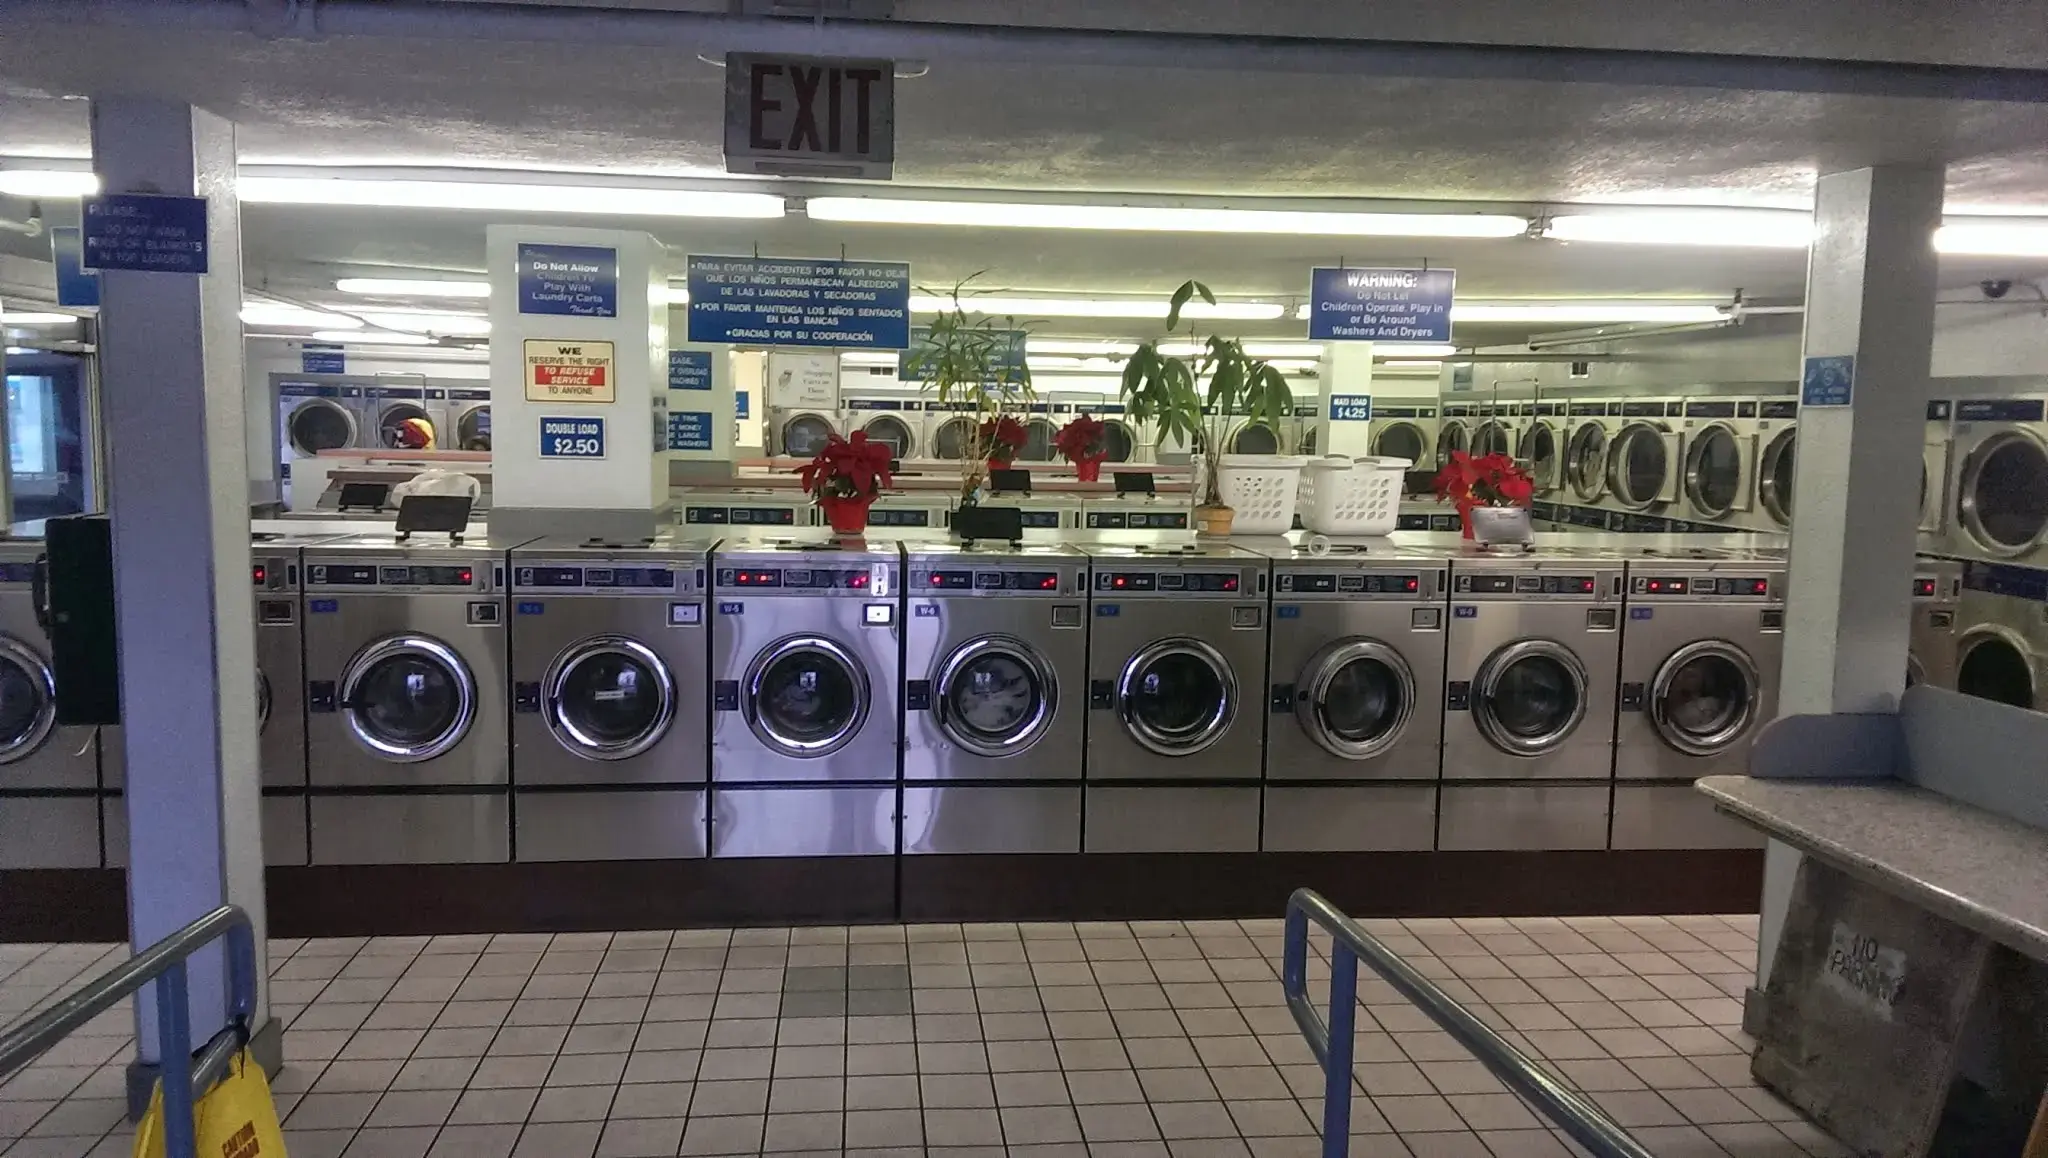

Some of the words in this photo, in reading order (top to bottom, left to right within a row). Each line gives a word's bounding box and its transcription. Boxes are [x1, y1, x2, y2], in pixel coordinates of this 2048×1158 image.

[750, 65, 881, 154] EXIT
[533, 262, 547, 270] Do
[550, 262, 568, 271] Not
[570, 263, 599, 273] Allow
[697, 262, 719, 271] PARA
[724, 263, 753, 272] EVITAR
[758, 264, 811, 275] ACCIDENTES
[816, 267, 834, 275] POR
[839, 267, 864, 276] FAVOR
[869, 269, 881, 277] NO
[537, 271, 581, 281] Children
[706, 274, 724, 283] QUE
[729, 275, 746, 283] LOS
[751, 274, 776, 284] NIÑOS
[781, 277, 844, 287] PERMANESCAN
[848, 280, 899, 288] ALREDEDOR
[1347, 272, 1418, 288] WARNING:
[544, 282, 566, 292] Play
[569, 283, 592, 292] With
[532, 292, 575, 303] Laundry
[576, 293, 603, 303] Carts
[721, 287, 733, 295] DE
[737, 288, 754, 296] LAS
[759, 289, 810, 298] LAVADORAS
[814, 291, 820, 299] Y
[824, 291, 876, 300] SECADORAS
[1357, 291, 1371, 300] Do
[1374, 291, 1392, 300] Not
[1394, 292, 1409, 300] Let
[701, 303, 719, 311] POR
[724, 303, 751, 312] FAVOR
[755, 304, 803, 314] MANTENGA
[807, 306, 825, 315] LOS
[829, 305, 854, 316] NIÑOS
[858, 308, 903, 318] SENTADOS
[1321, 302, 1363, 311] Children
[1410, 303, 1431, 315] Play
[766, 315, 779, 323] EN
[782, 315, 799, 324] LAS
[804, 316, 839, 326] BANCAS
[1350, 316, 1360, 324] or
[1364, 315, 1377, 324] Be
[1380, 315, 1417, 325] Around
[732, 329, 770, 338] GRACIAS
[774, 330, 792, 339] POR
[796, 331, 808, 339] SU
[812, 330, 873, 341] COOPERACIÓN
[1332, 326, 1375, 336] Washers
[1377, 326, 1398, 336] And
[1400, 327, 1433, 338] Dryers
[558, 347, 582, 356] WE
[529, 356, 564, 364] RESERVE
[569, 357, 584, 365] THE
[587, 358, 610, 366] RIGHT
[544, 367, 556, 375] TO
[560, 367, 596, 375] REFUSE
[551, 376, 589, 384] SERVICE
[561, 387, 593, 395] ANYONE
[1351, 398, 1367, 406] LOAD
[1337, 407, 1366, 418] $4.25
[546, 423, 576, 434] DOUBLE
[578, 424, 598, 434] LOAD
[554, 438, 599, 454] $2.50
[1831, 949, 1904, 1006] PARKNG
